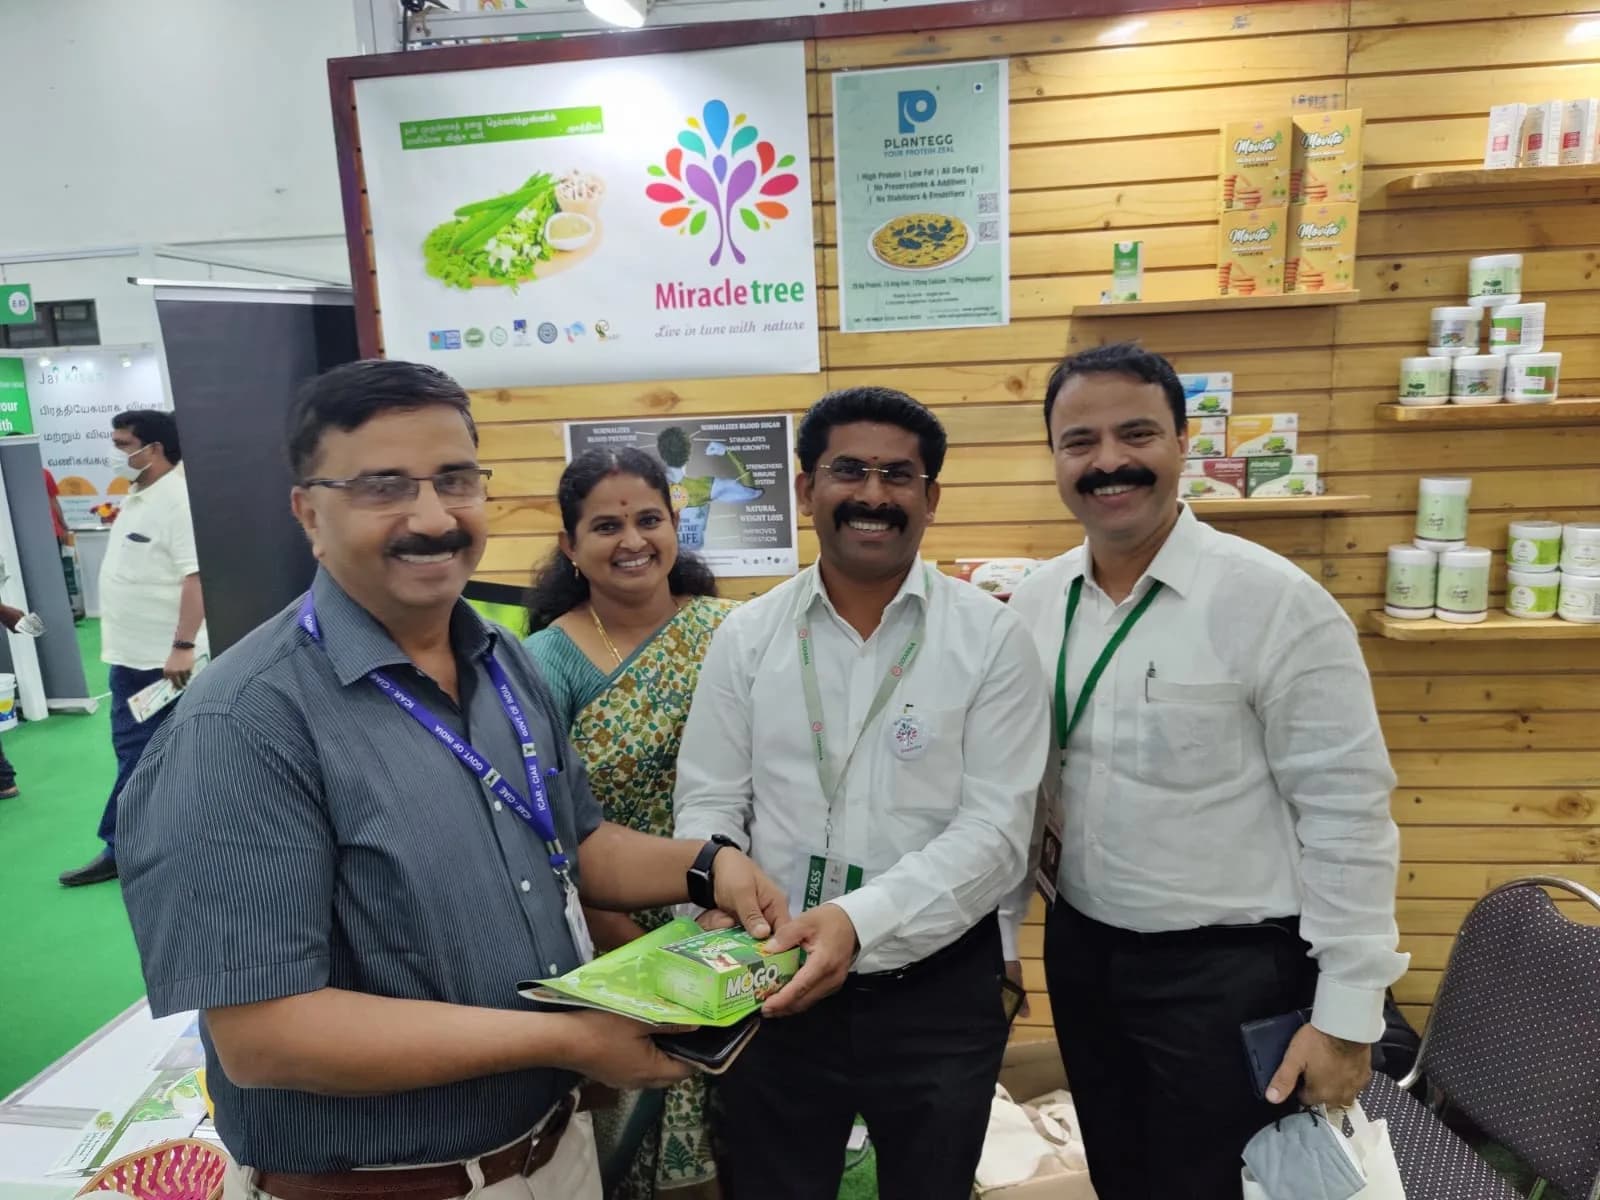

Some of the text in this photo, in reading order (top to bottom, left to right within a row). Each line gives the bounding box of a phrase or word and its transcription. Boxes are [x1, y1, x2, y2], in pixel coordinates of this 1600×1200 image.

[884, 134, 953, 149] PLANTEGG
[655, 319, 806, 338] Live in tune with nature
[0, 402, 18, 413] our
[745, 504, 776, 512] NATURAL
[739, 513, 784, 522] WEIGHT LOSS
[393, 690, 415, 709] ICAR
[509, 704, 519, 716] OF
[434, 725, 455, 744] INDIA
[452, 742, 465, 753] OF
[534, 790, 546, 811] ICAR
[809, 870, 822, 897] PASS
[726, 964, 779, 999] MOGO
